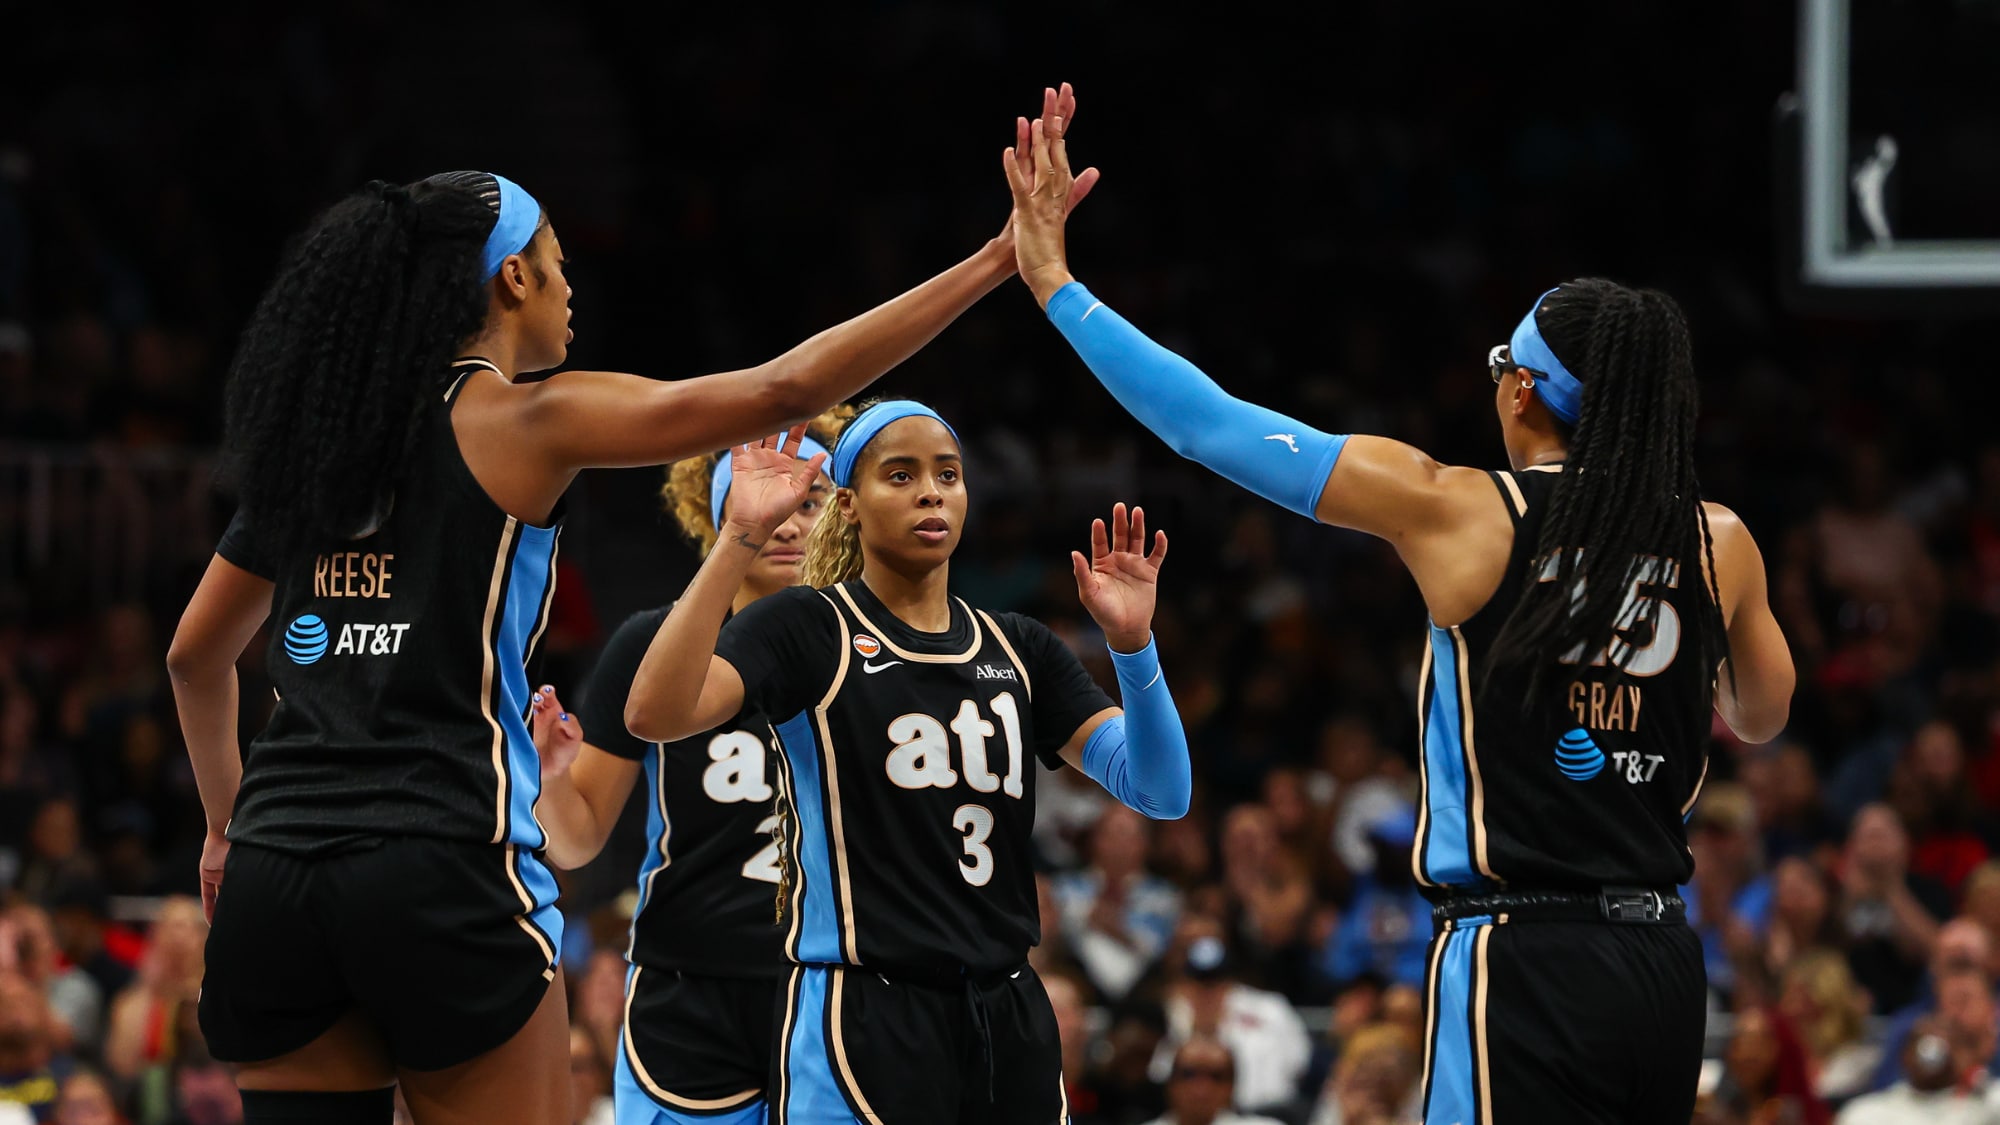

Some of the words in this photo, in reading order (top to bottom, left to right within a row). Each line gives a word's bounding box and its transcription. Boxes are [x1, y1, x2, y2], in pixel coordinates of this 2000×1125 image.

[314, 552, 394, 598] REESE
[334, 622, 410, 655] AT&T
[976, 664, 1019, 682] Albert
[1568, 680, 1642, 732] GRAY
[885, 691, 1023, 800] atl
[1612, 750, 1665, 784] T&T
[740, 814, 790, 886] 2
[952, 804, 994, 887] 3
